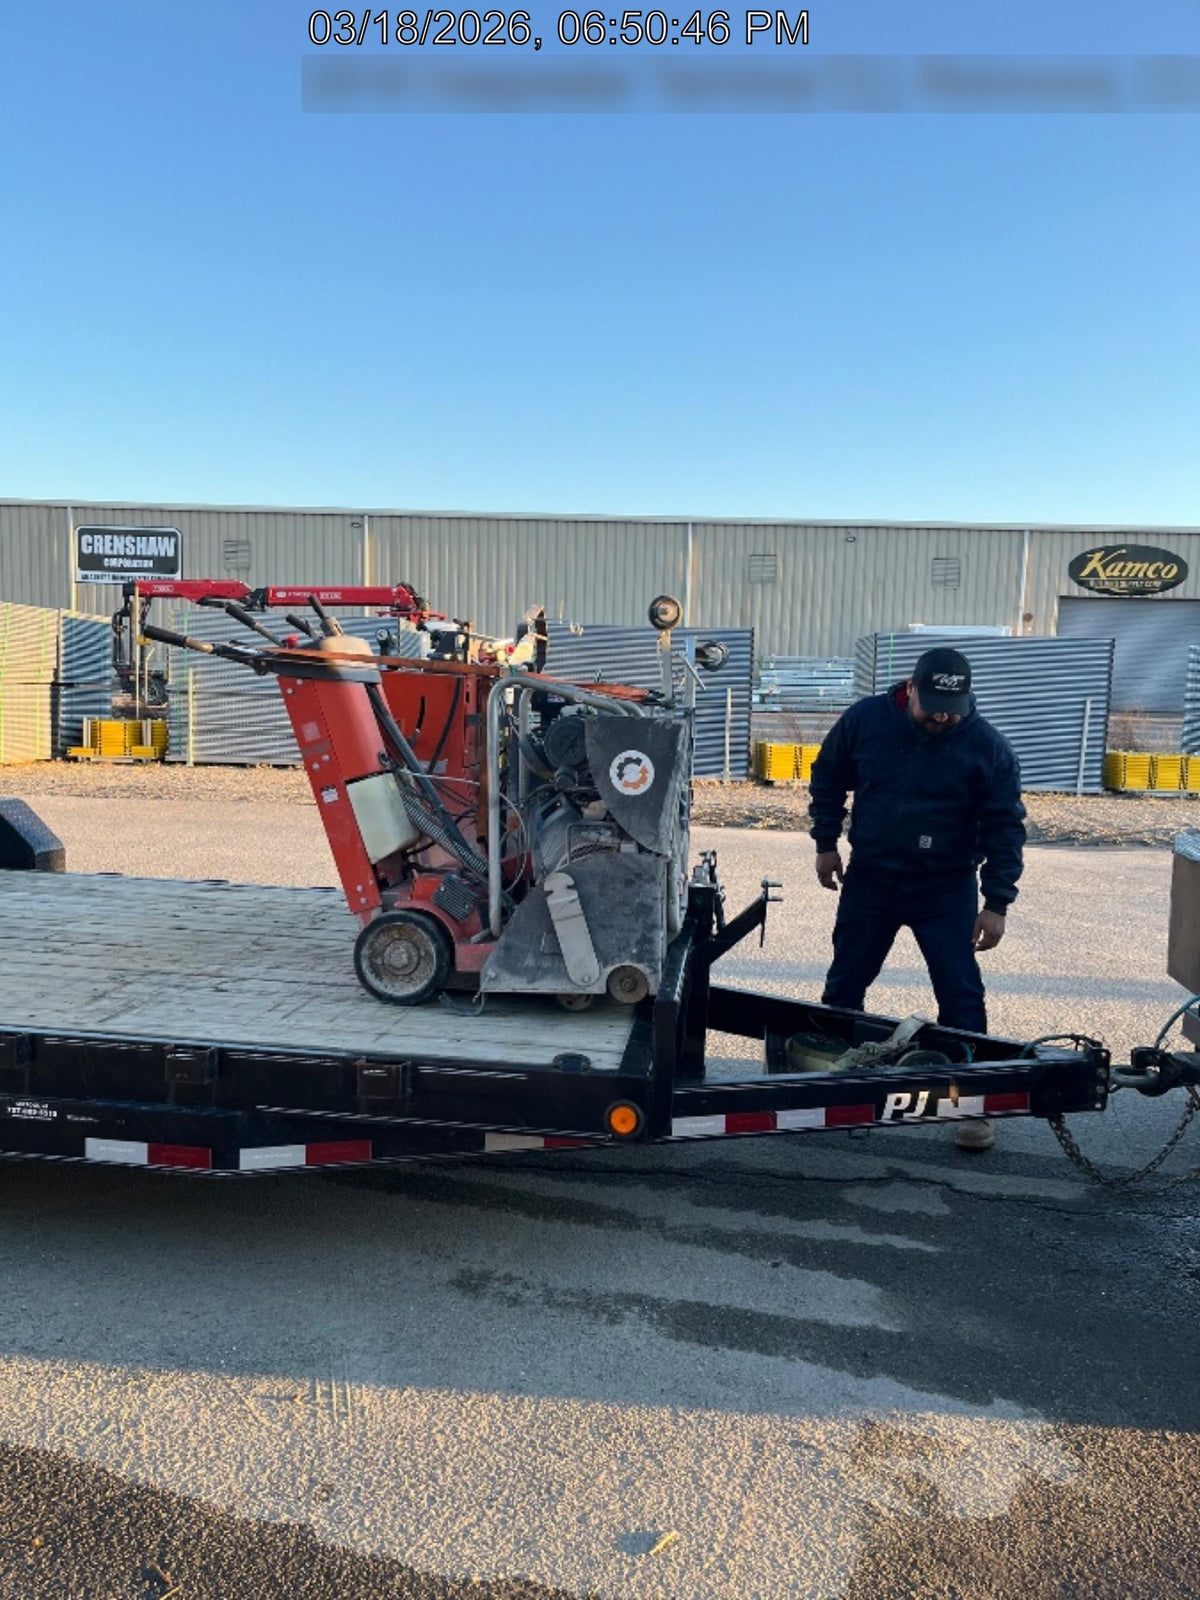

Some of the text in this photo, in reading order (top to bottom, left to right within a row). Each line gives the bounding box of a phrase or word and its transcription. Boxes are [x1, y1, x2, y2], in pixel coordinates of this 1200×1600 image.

[81, 535, 176, 557] CRENSHAW
[1079, 548, 1178, 580] Kamco
[881, 1090, 931, 1120] PJ
